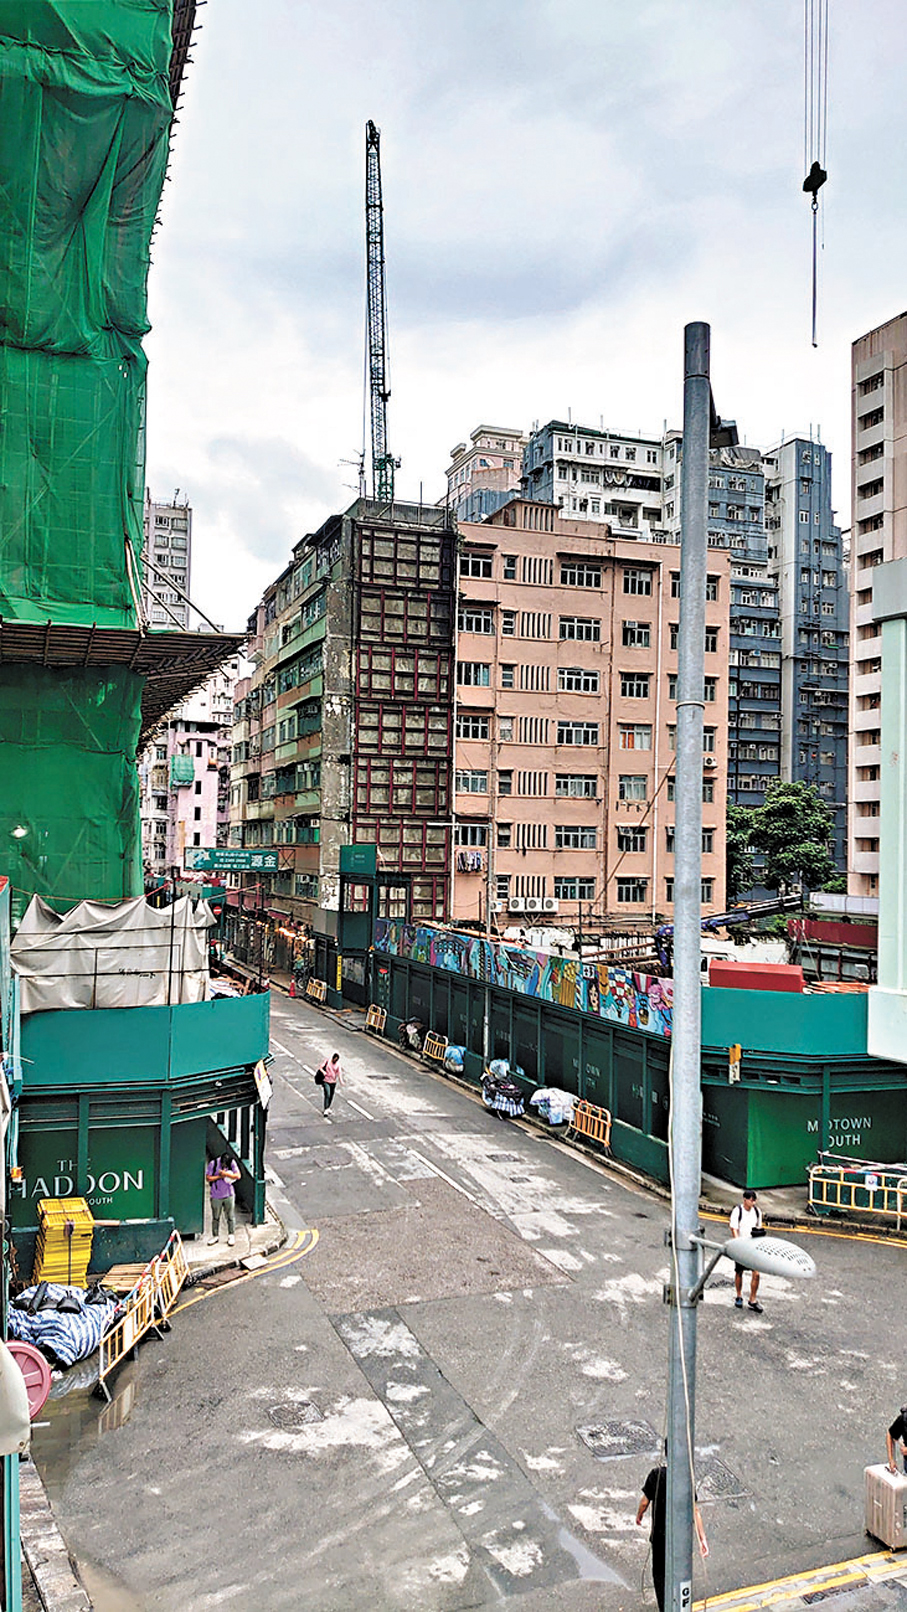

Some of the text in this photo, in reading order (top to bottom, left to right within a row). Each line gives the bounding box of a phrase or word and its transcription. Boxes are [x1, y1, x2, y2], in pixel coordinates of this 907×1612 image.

[807, 1116, 872, 1132] MTOWN
[828, 1134, 861, 1148] OUTH
[57, 1157, 92, 1172] TH
[86, 1197, 113, 1206] OUTH
